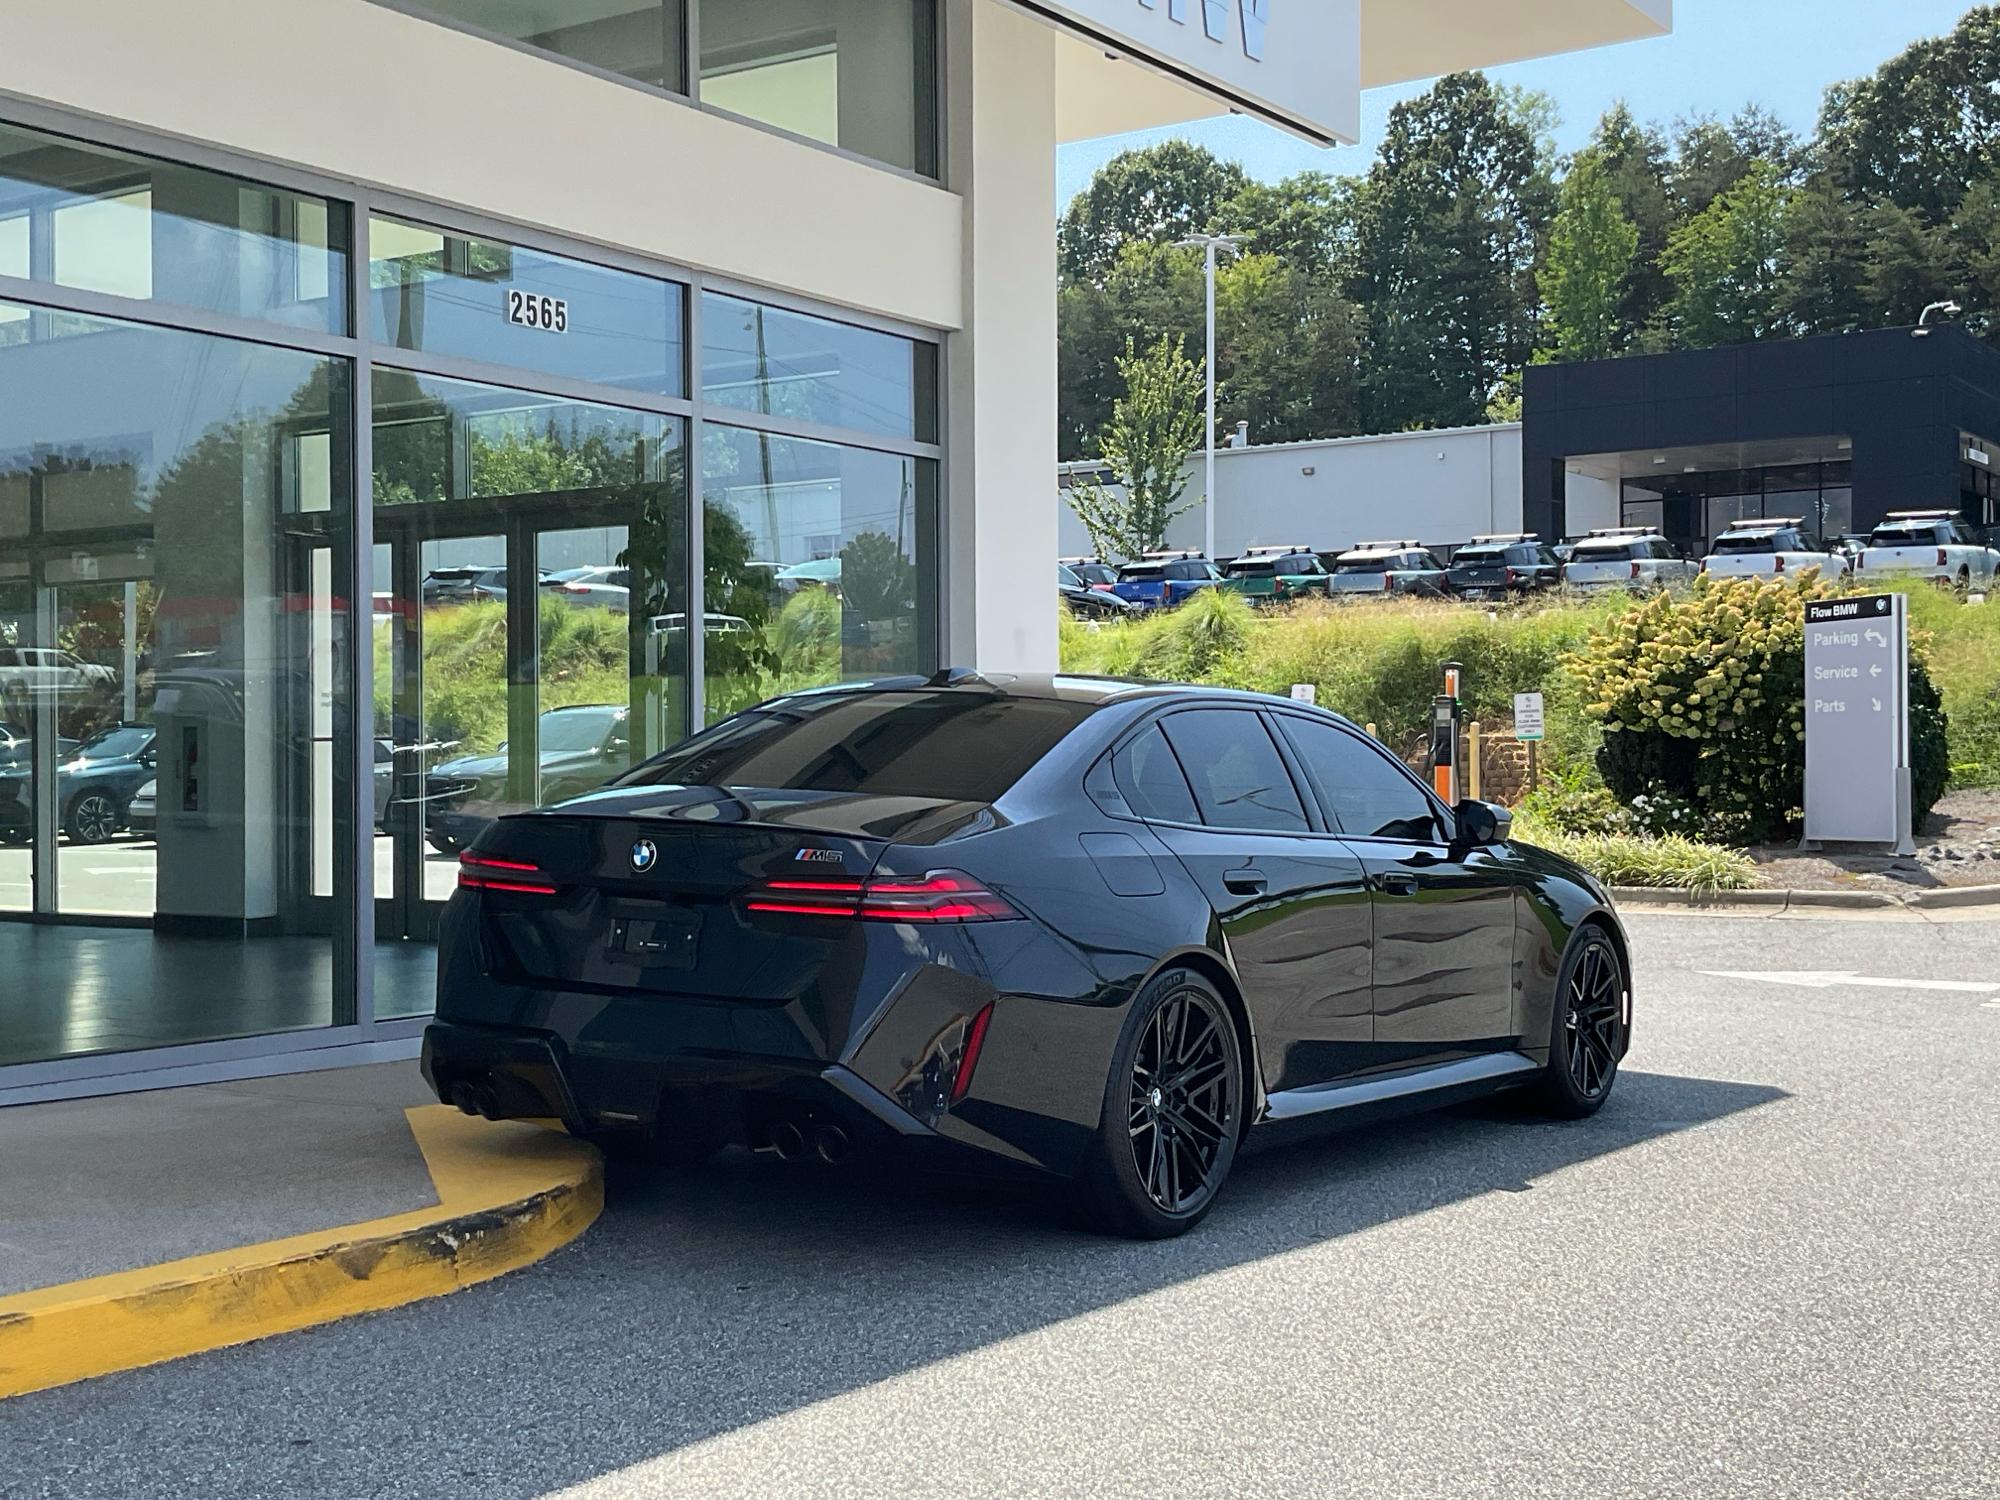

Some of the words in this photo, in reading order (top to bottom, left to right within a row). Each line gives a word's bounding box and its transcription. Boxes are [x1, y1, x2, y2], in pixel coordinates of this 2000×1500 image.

[511, 291, 566, 332] 2565
[1811, 606, 1832, 618] Flow
[1833, 603, 1858, 616] BMW
[1814, 631, 1858, 646] Parking
[1814, 665, 1858, 679] Service
[1814, 699, 1846, 713] Parts
